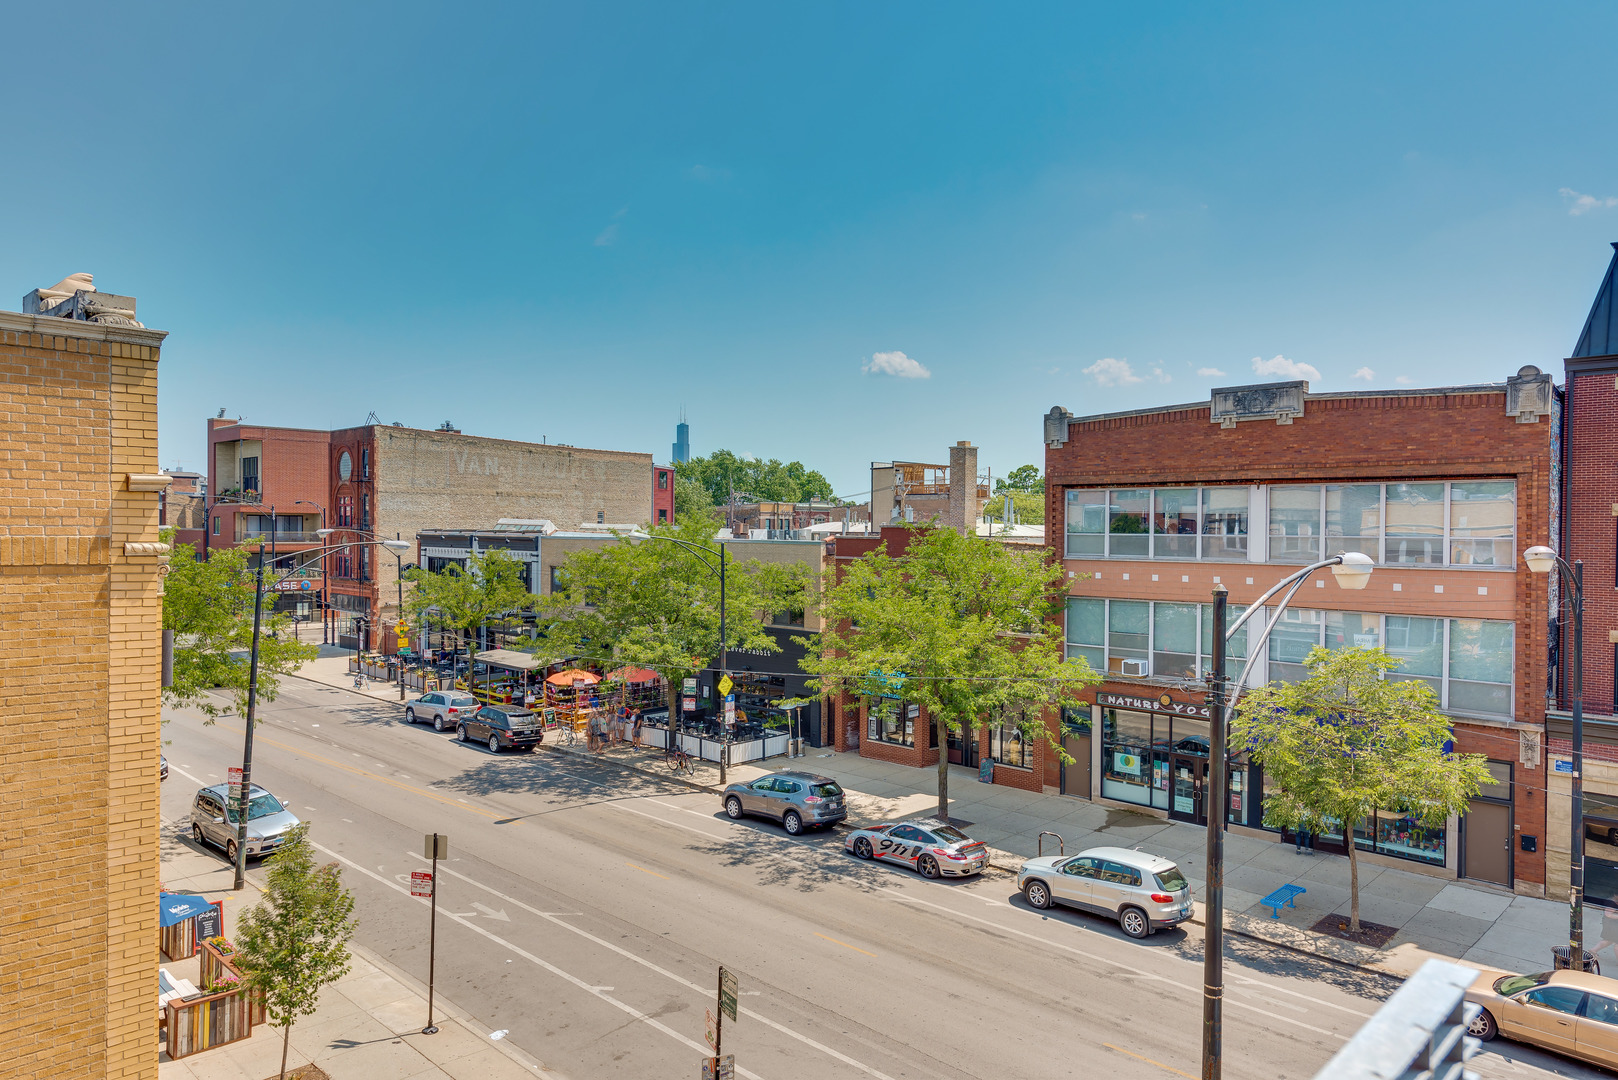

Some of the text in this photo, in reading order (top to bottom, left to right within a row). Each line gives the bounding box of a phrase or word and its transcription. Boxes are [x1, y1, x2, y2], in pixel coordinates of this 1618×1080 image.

[454, 449, 499, 476] VAN
[1107, 695, 1210, 717] NATURE YOG
[880, 839, 909, 856] 911
